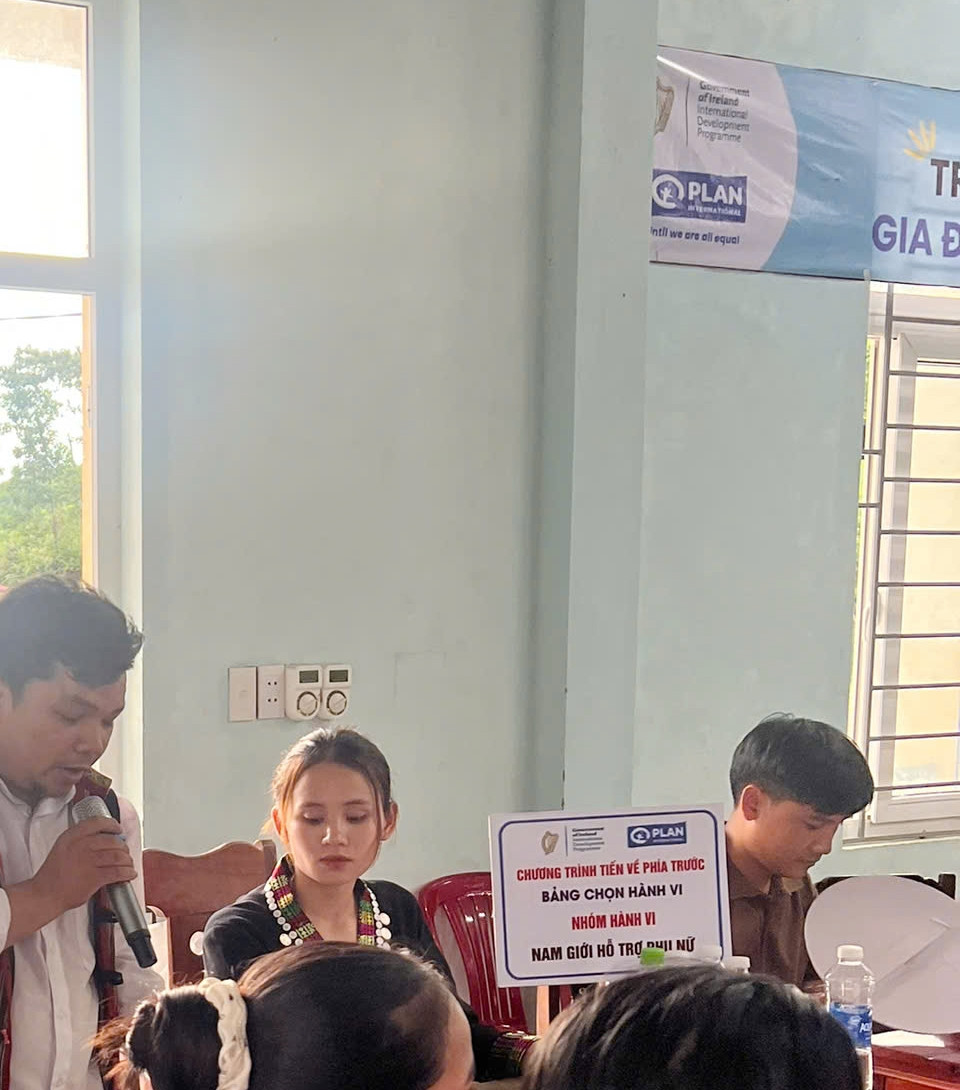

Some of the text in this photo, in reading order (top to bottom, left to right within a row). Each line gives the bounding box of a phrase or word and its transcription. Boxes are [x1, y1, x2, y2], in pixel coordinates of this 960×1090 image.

[688, 181, 743, 205] PLAN
[670, 231, 683, 239] we
[685, 232, 700, 240] are
[702, 231, 713, 242] all
[714, 235, 740, 246] equal
[872, 214, 933, 256] GIA
[652, 827, 684, 838] PLAN
[517, 867, 561, 881] CHƯƠNG
[565, 863, 597, 878] TRÌNH
[600, 860, 624, 877] TIẾN
[643, 859, 668, 874] PHÍA
[671, 856, 705, 872] TRƯỚC
[542, 883, 683, 903] BẢNG CHỌN HÀNH VI
[572, 911, 656, 930] NHÓM HÀNH VI
[532, 946, 562, 962] NAM
[567, 942, 593, 960] GIỚI
[597, 939, 614, 958] HỖ
[618, 940, 643, 959] TRỢ
[676, 936, 696, 953] NỮ
